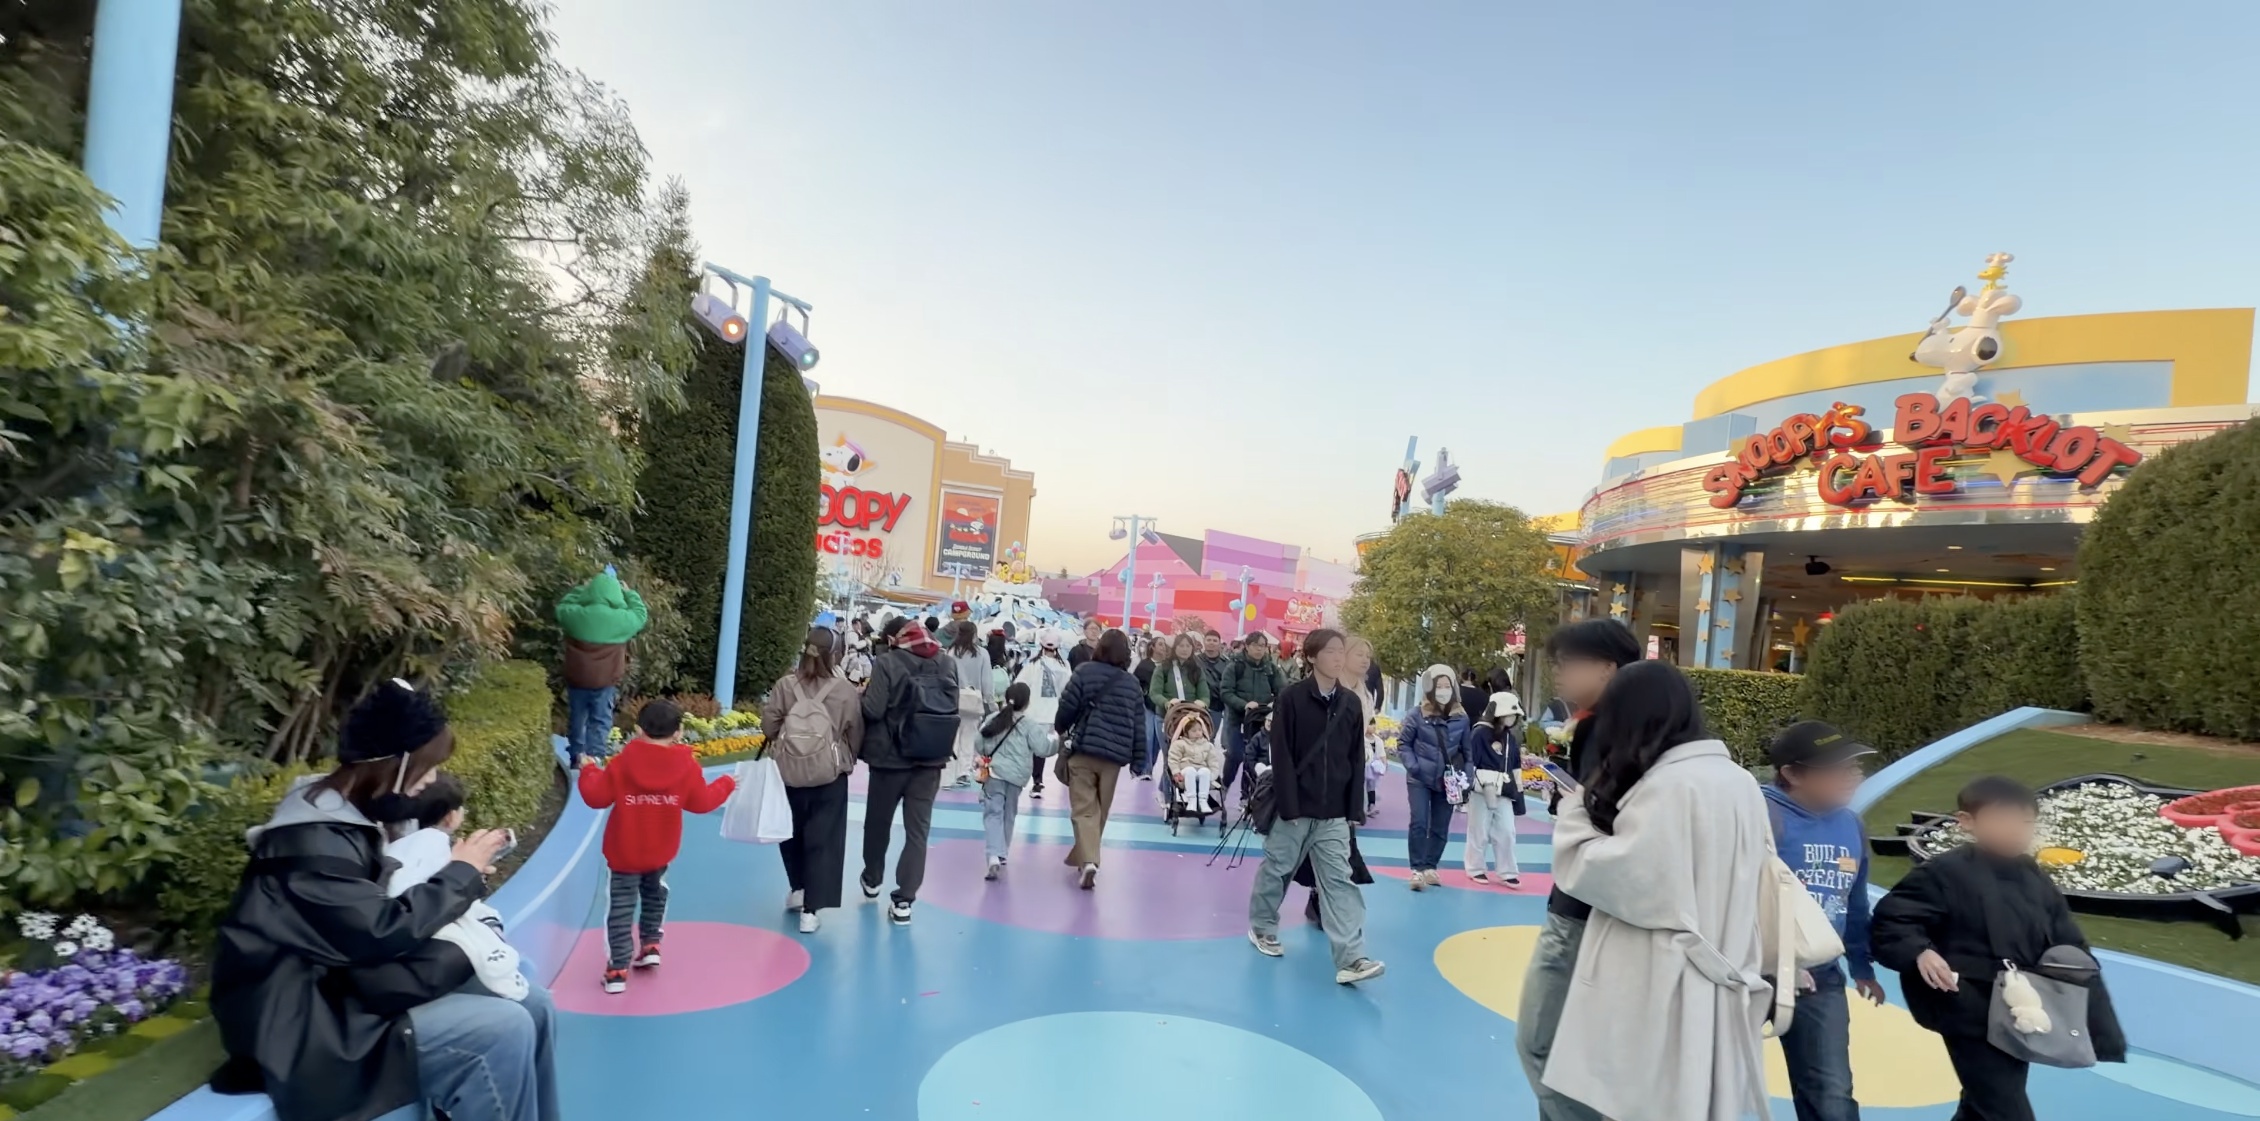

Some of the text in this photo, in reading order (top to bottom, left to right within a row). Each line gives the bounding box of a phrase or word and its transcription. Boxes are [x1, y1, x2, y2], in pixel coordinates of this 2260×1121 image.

[1702, 393, 2142, 509] SNOOPY'S BACKLOT
[1818, 446, 1956, 505] CAFE
[625, 794, 680, 806] SUPREME
